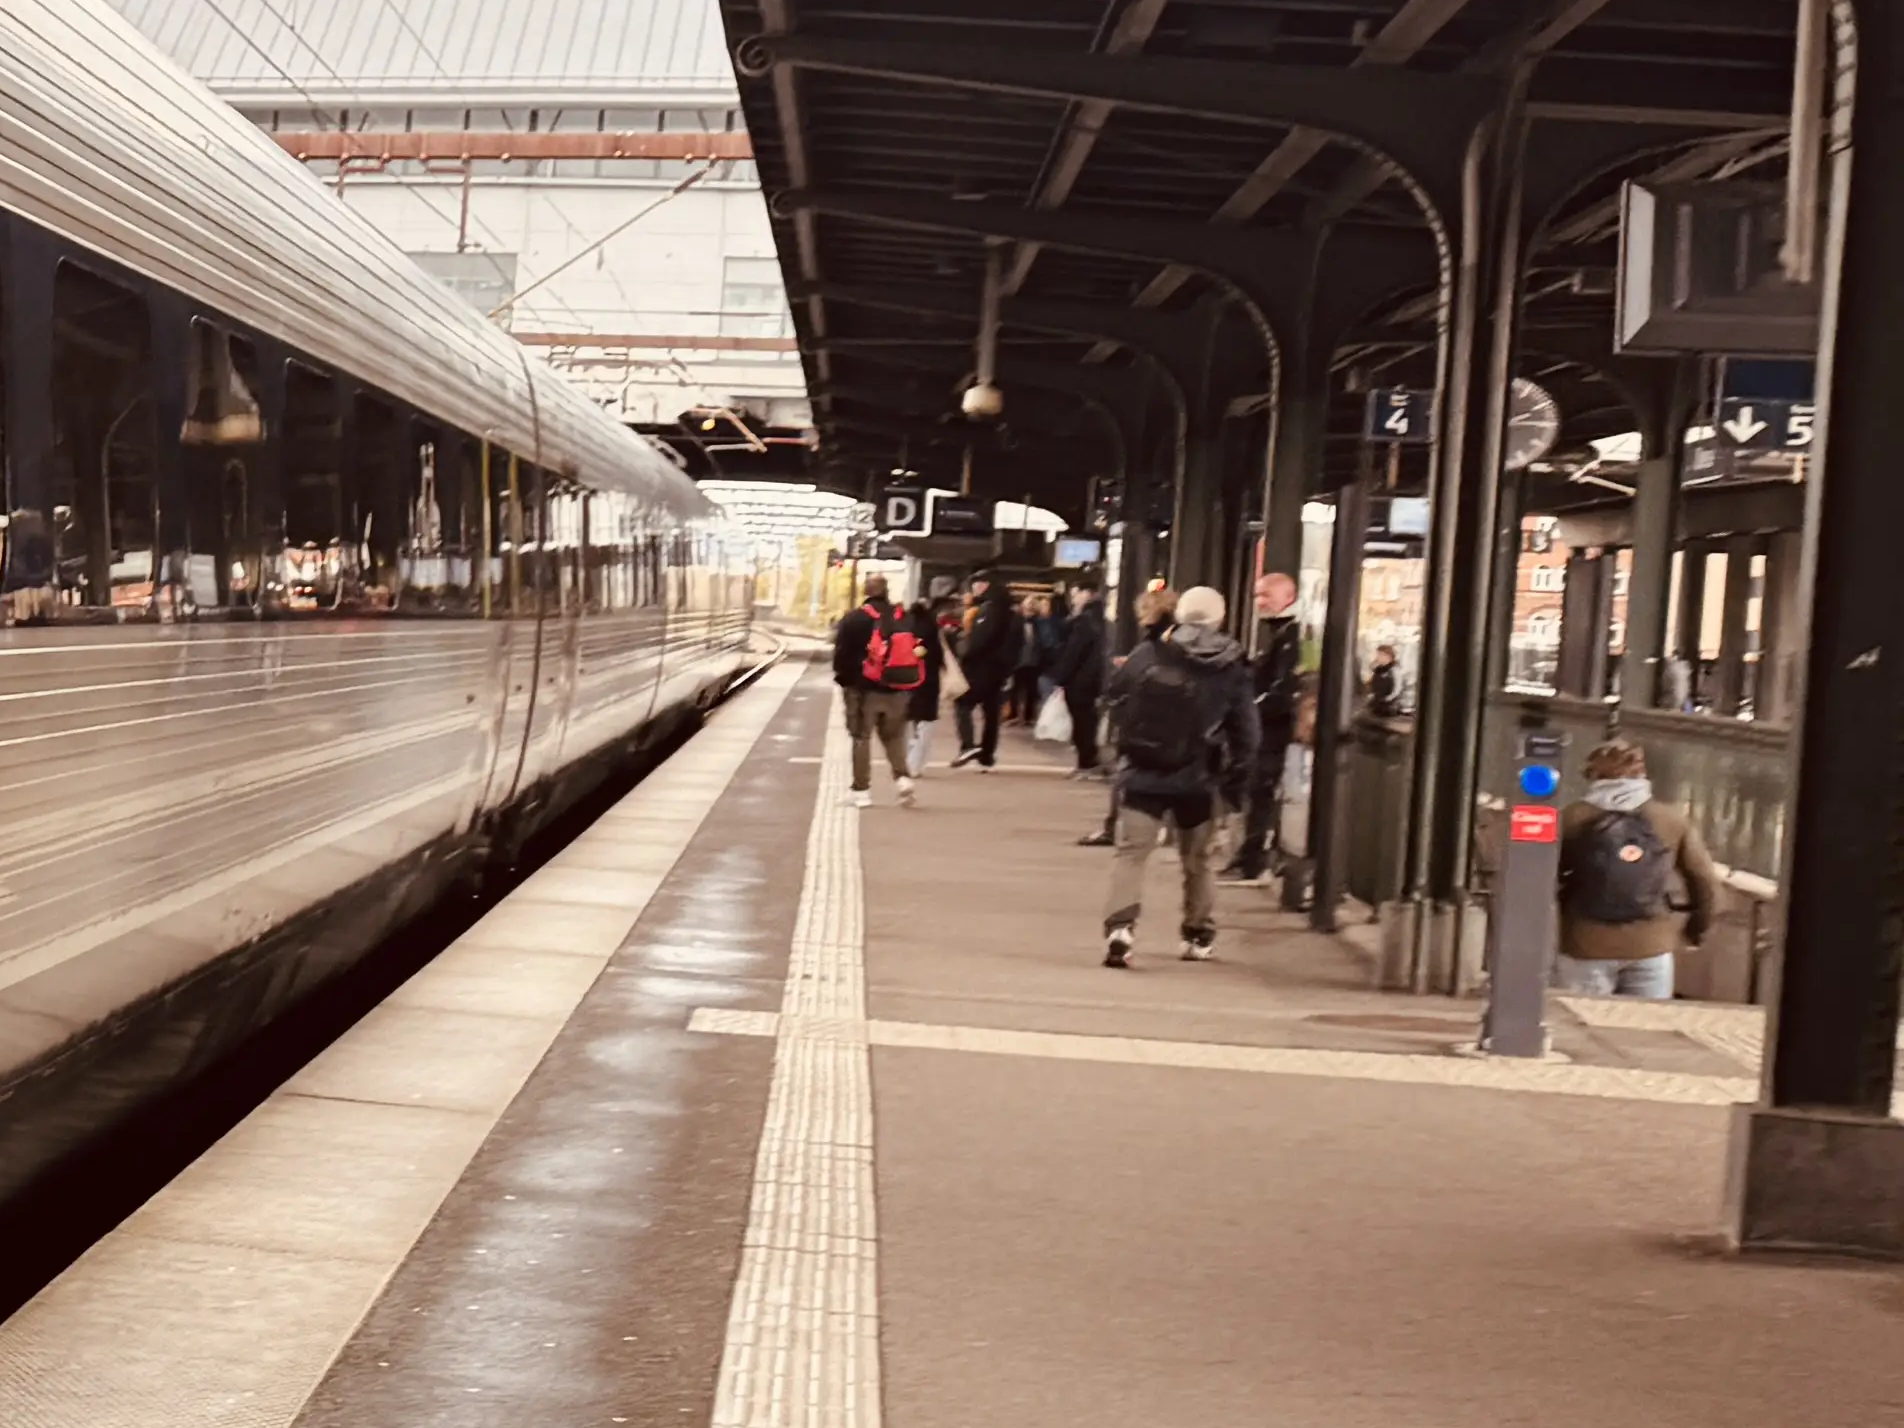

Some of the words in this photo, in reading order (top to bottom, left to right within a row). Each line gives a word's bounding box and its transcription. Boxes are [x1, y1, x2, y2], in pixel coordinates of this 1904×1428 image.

[1384, 407, 1409, 435] 4
[1784, 415, 1815, 446] 5
[886, 496, 917, 527] D
